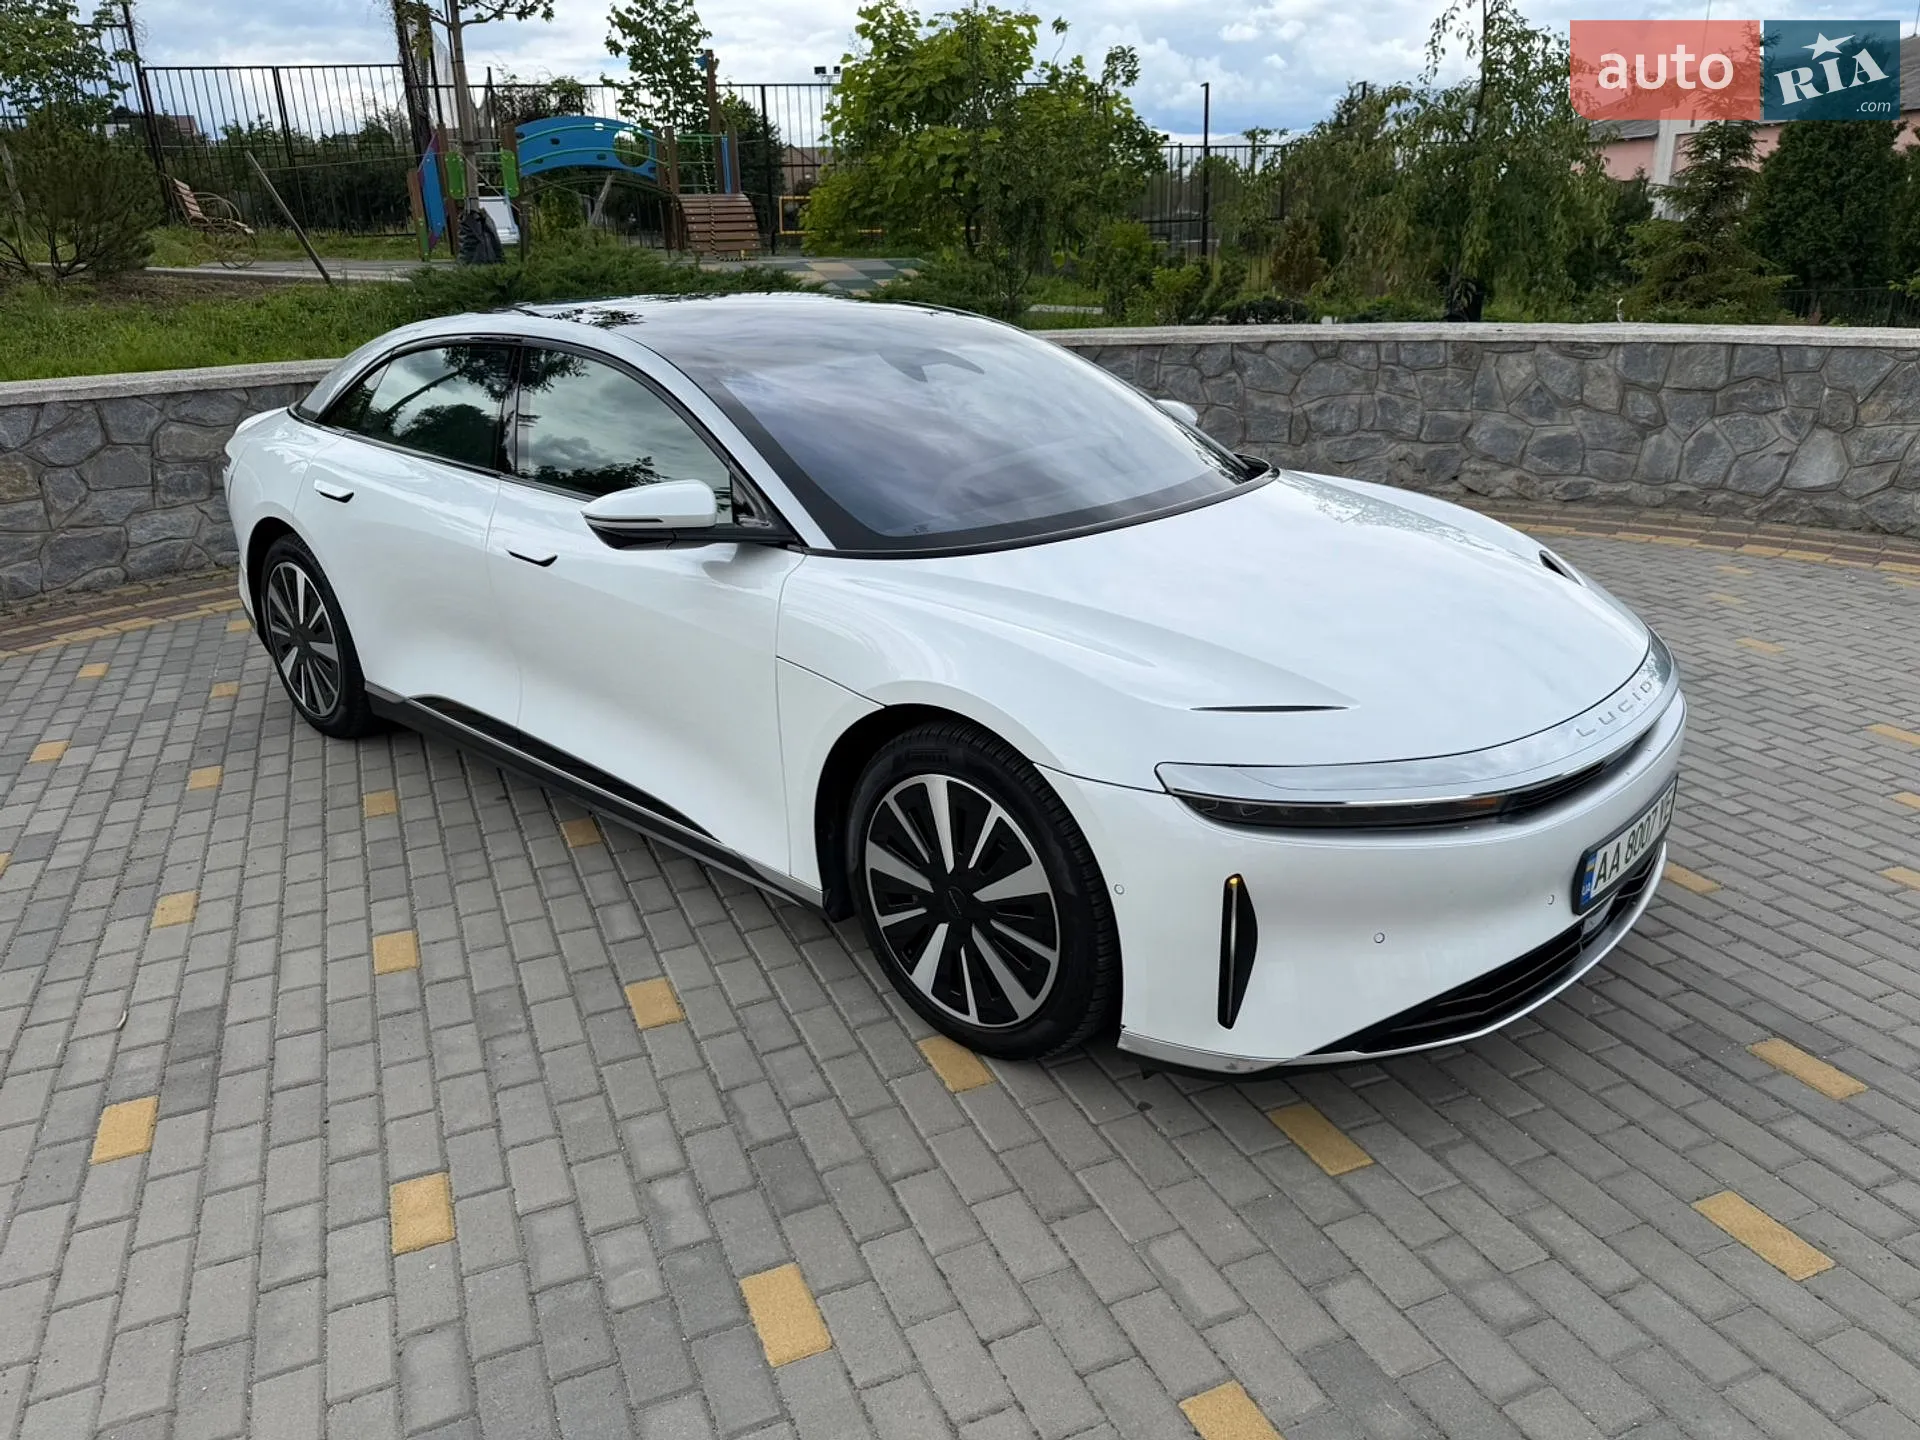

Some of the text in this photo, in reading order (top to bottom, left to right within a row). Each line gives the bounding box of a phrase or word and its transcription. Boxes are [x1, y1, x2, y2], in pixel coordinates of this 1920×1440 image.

[1576, 681, 1652, 737] LUCID
[1594, 842, 1622, 890] AA
[1624, 807, 1659, 865] 8007
